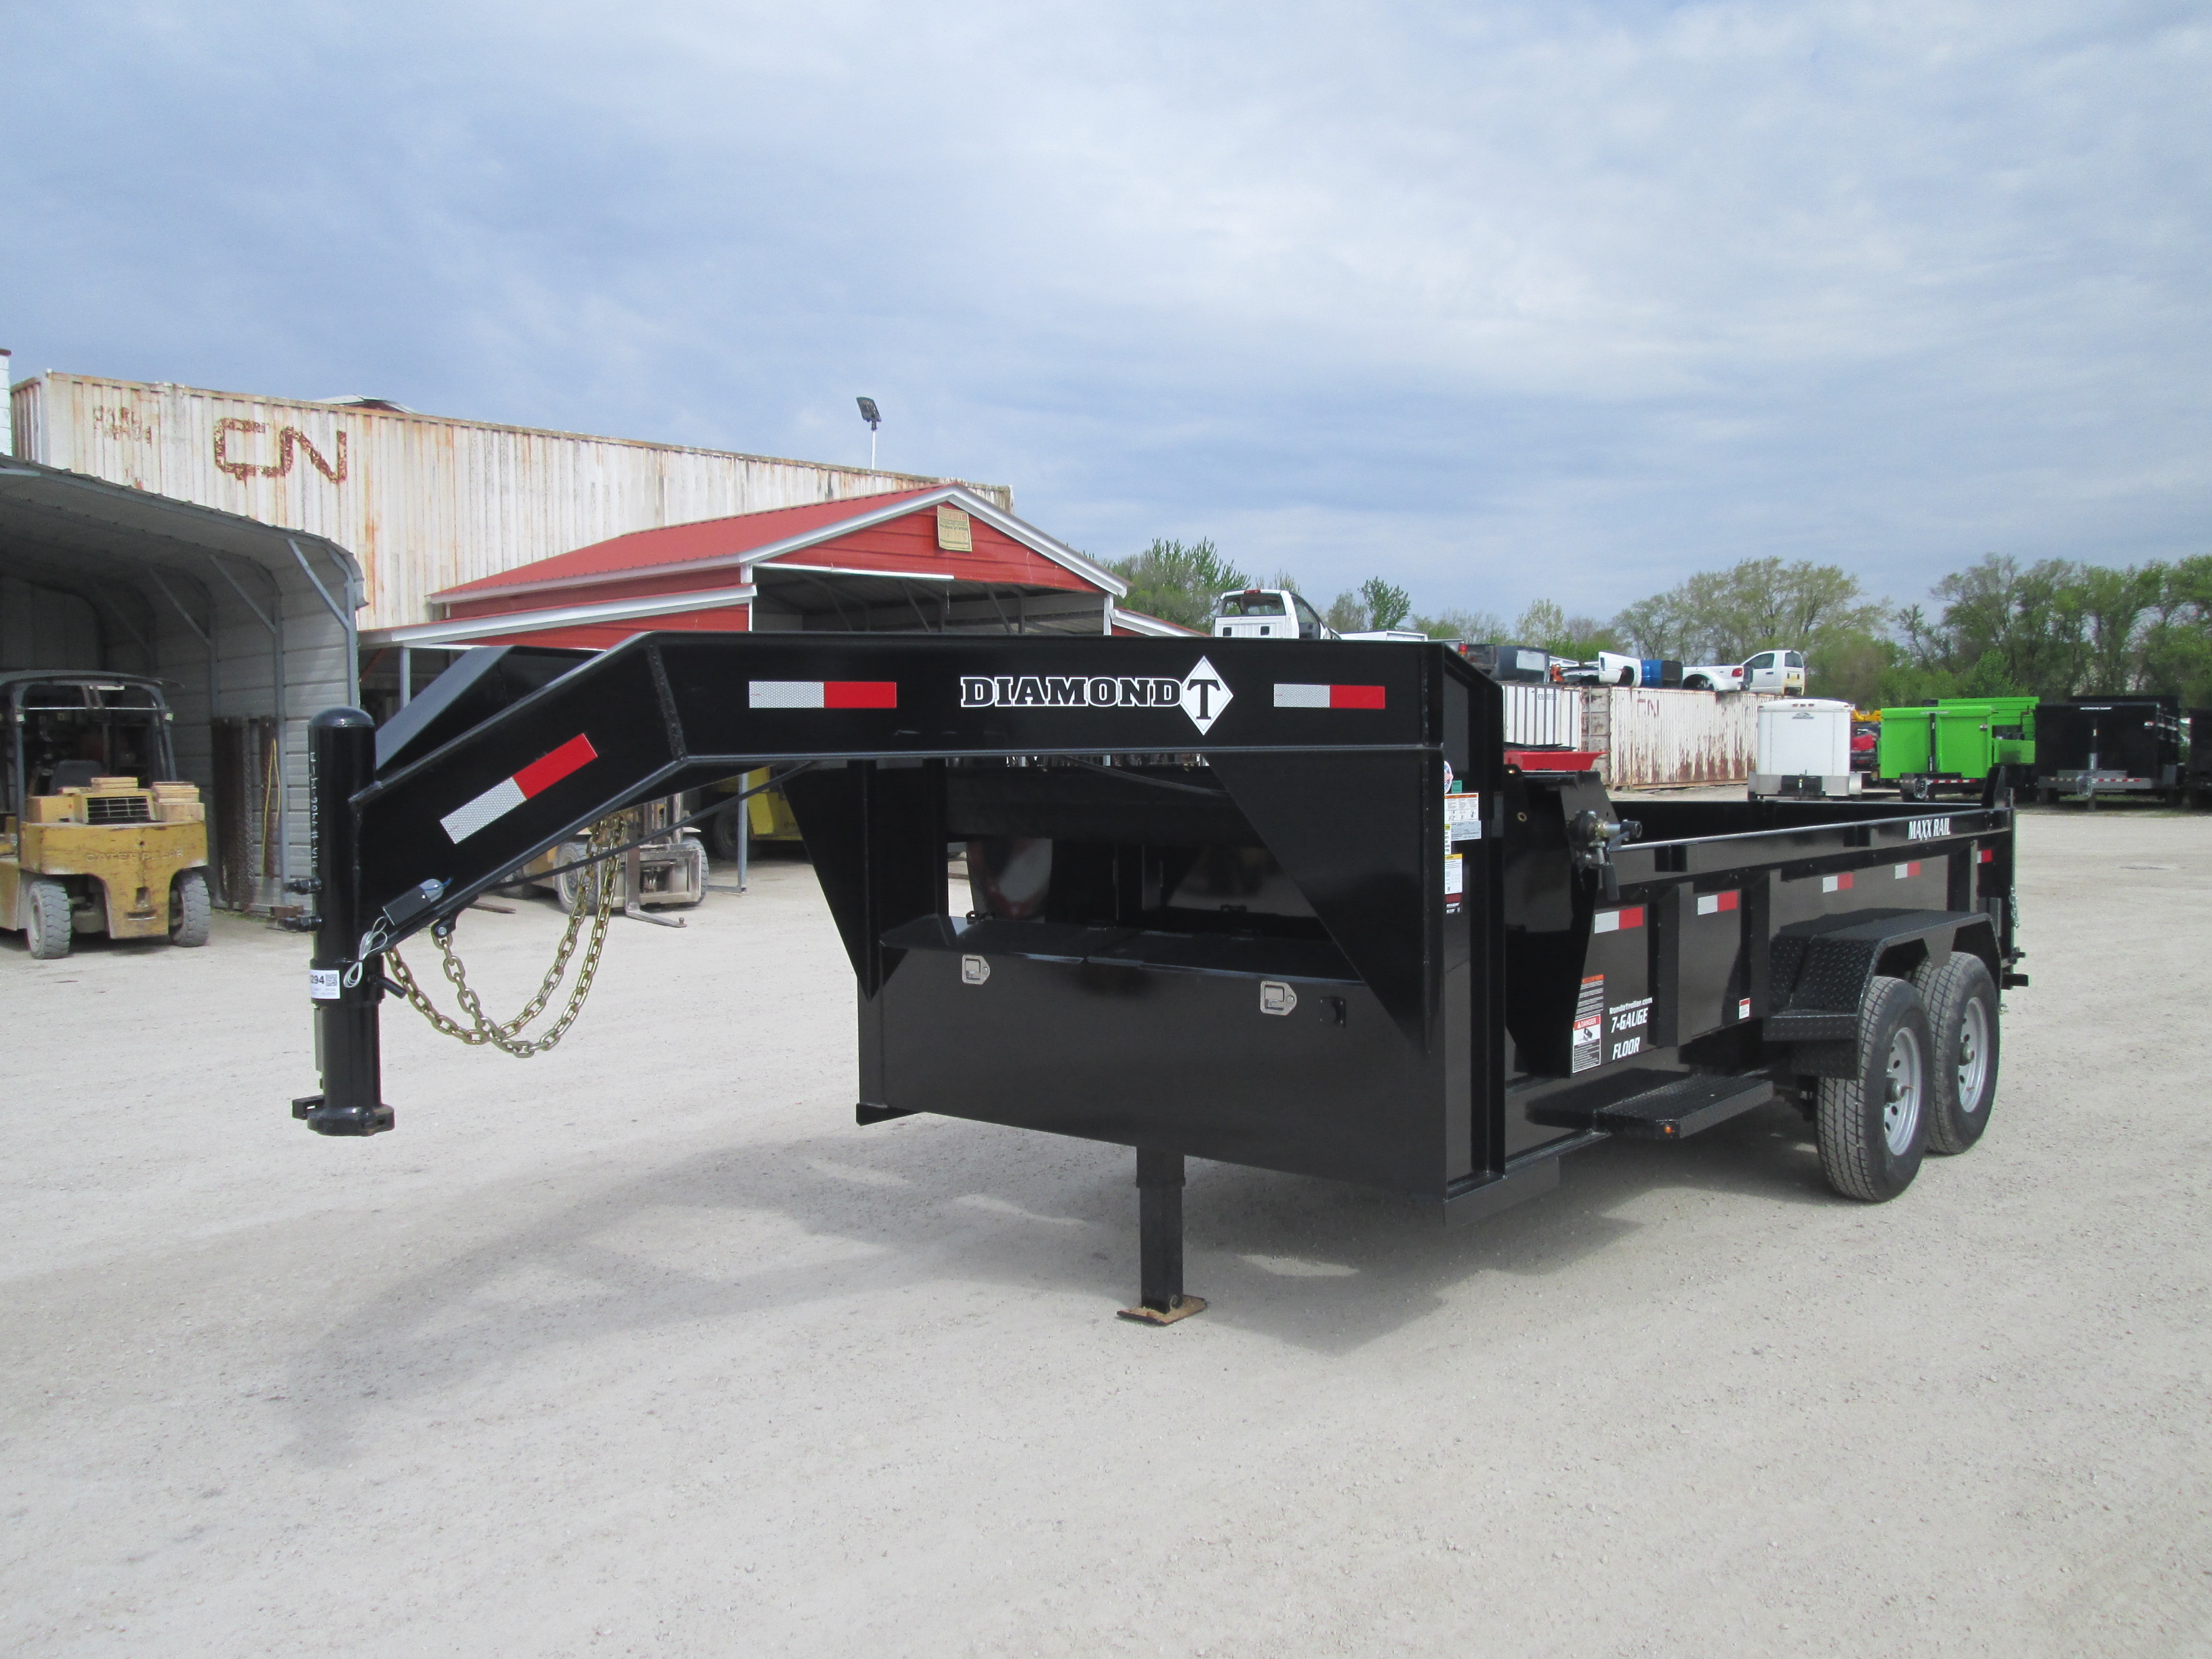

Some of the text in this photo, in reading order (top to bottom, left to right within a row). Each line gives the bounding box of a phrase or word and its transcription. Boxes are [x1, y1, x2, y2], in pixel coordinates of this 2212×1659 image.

[961, 676, 1221, 720] DIAMOND T
[1908, 817, 1951, 841] MAXX RAIL
[1580, 1017, 1597, 1028] DANGER
[1610, 1007, 1649, 1033] 7-GAUGE
[1612, 1036, 1641, 1061] FLOOR
